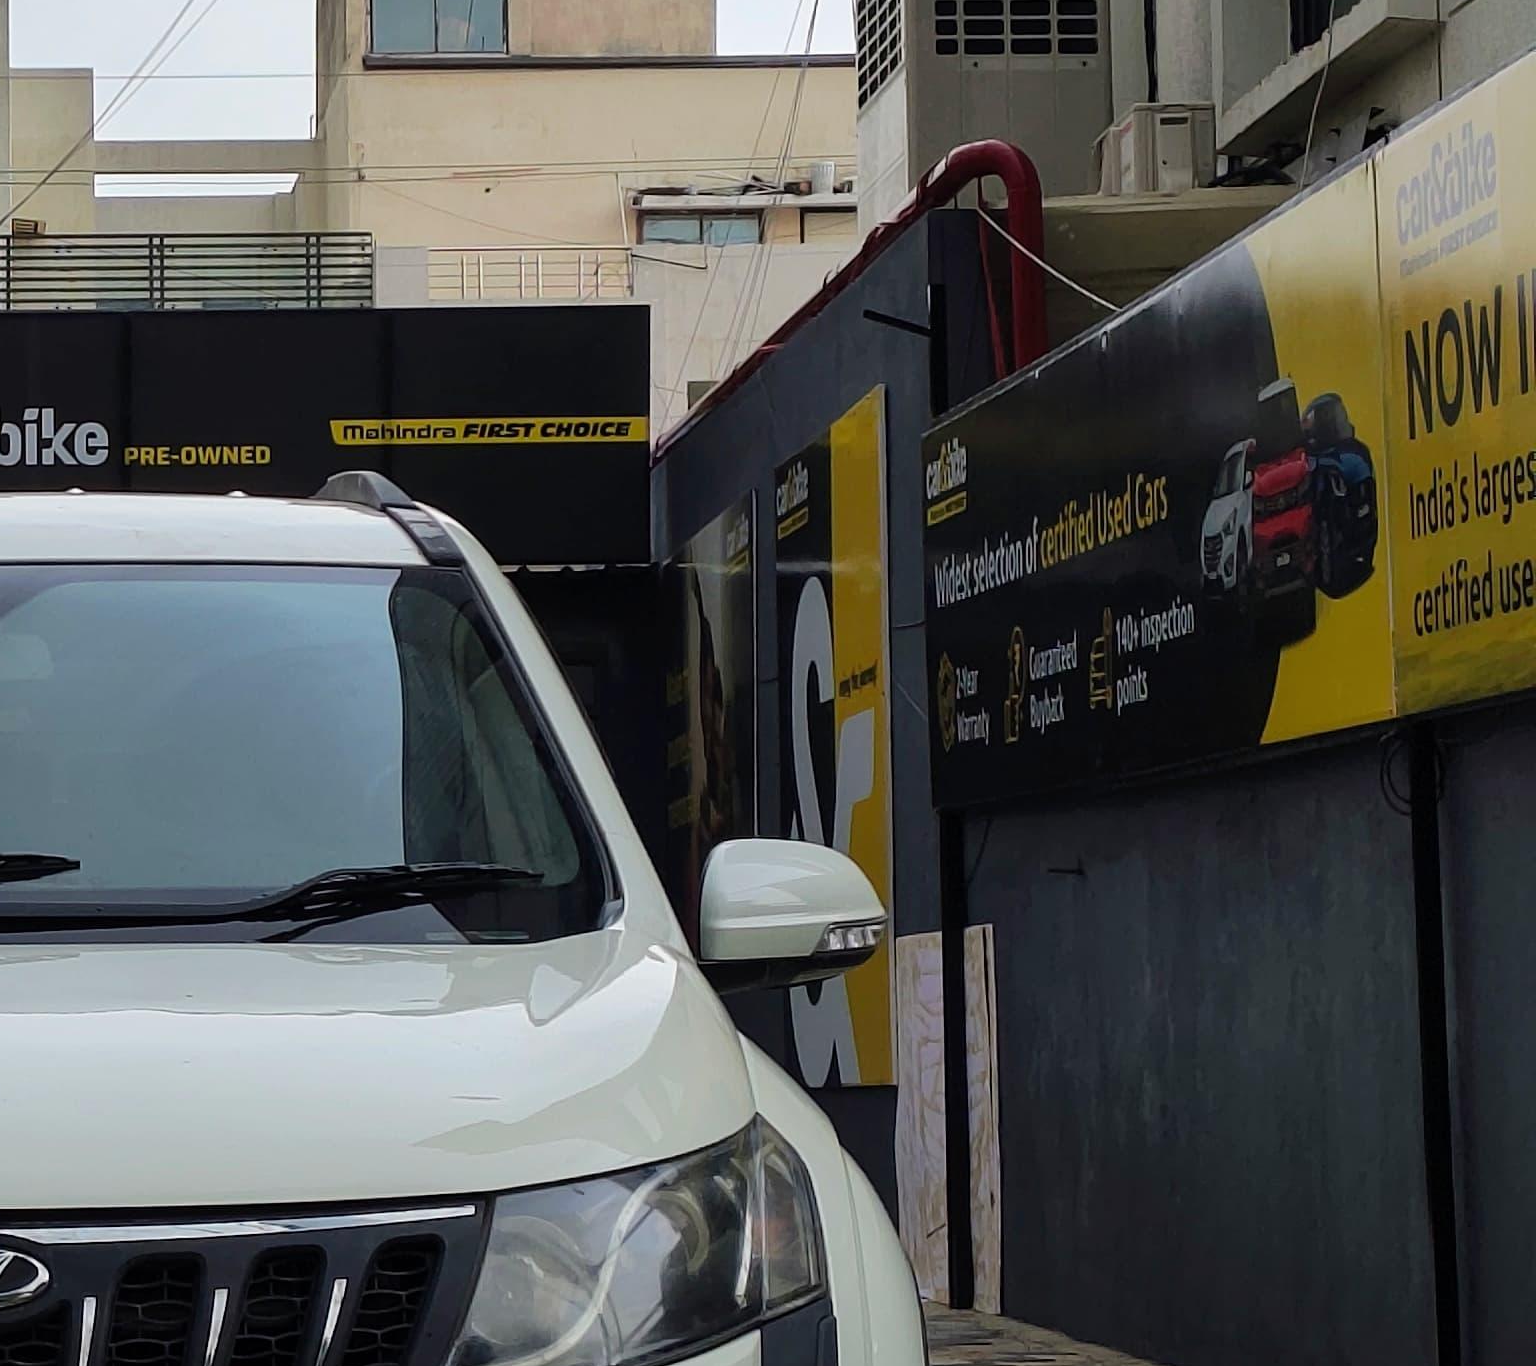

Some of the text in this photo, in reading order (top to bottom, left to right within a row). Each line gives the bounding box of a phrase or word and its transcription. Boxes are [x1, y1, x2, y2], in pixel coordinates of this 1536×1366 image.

[1396, 119, 1497, 246] car&bike
[1405, 285, 1502, 440] NOW
[124, 445, 271, 466] PRE-OWNED
[343, 421, 631, 440] Mahindra FIRST CHOICE
[1409, 459, 1469, 541] India's
[934, 553, 972, 608] Widest
[973, 531, 1024, 596] selection
[1025, 515, 1038, 575] of
[1040, 492, 1094, 569] certified
[1096, 473, 1132, 546] Used
[1135, 472, 1168, 529] Cars
[1414, 549, 1494, 637] certified
[1140, 595, 1195, 653] inspection
[1029, 630, 1078, 680] Guaranteed
[1030, 683, 1064, 734] Buyback
[1116, 665, 1148, 716] points
[957, 707, 990, 745] Warranty
